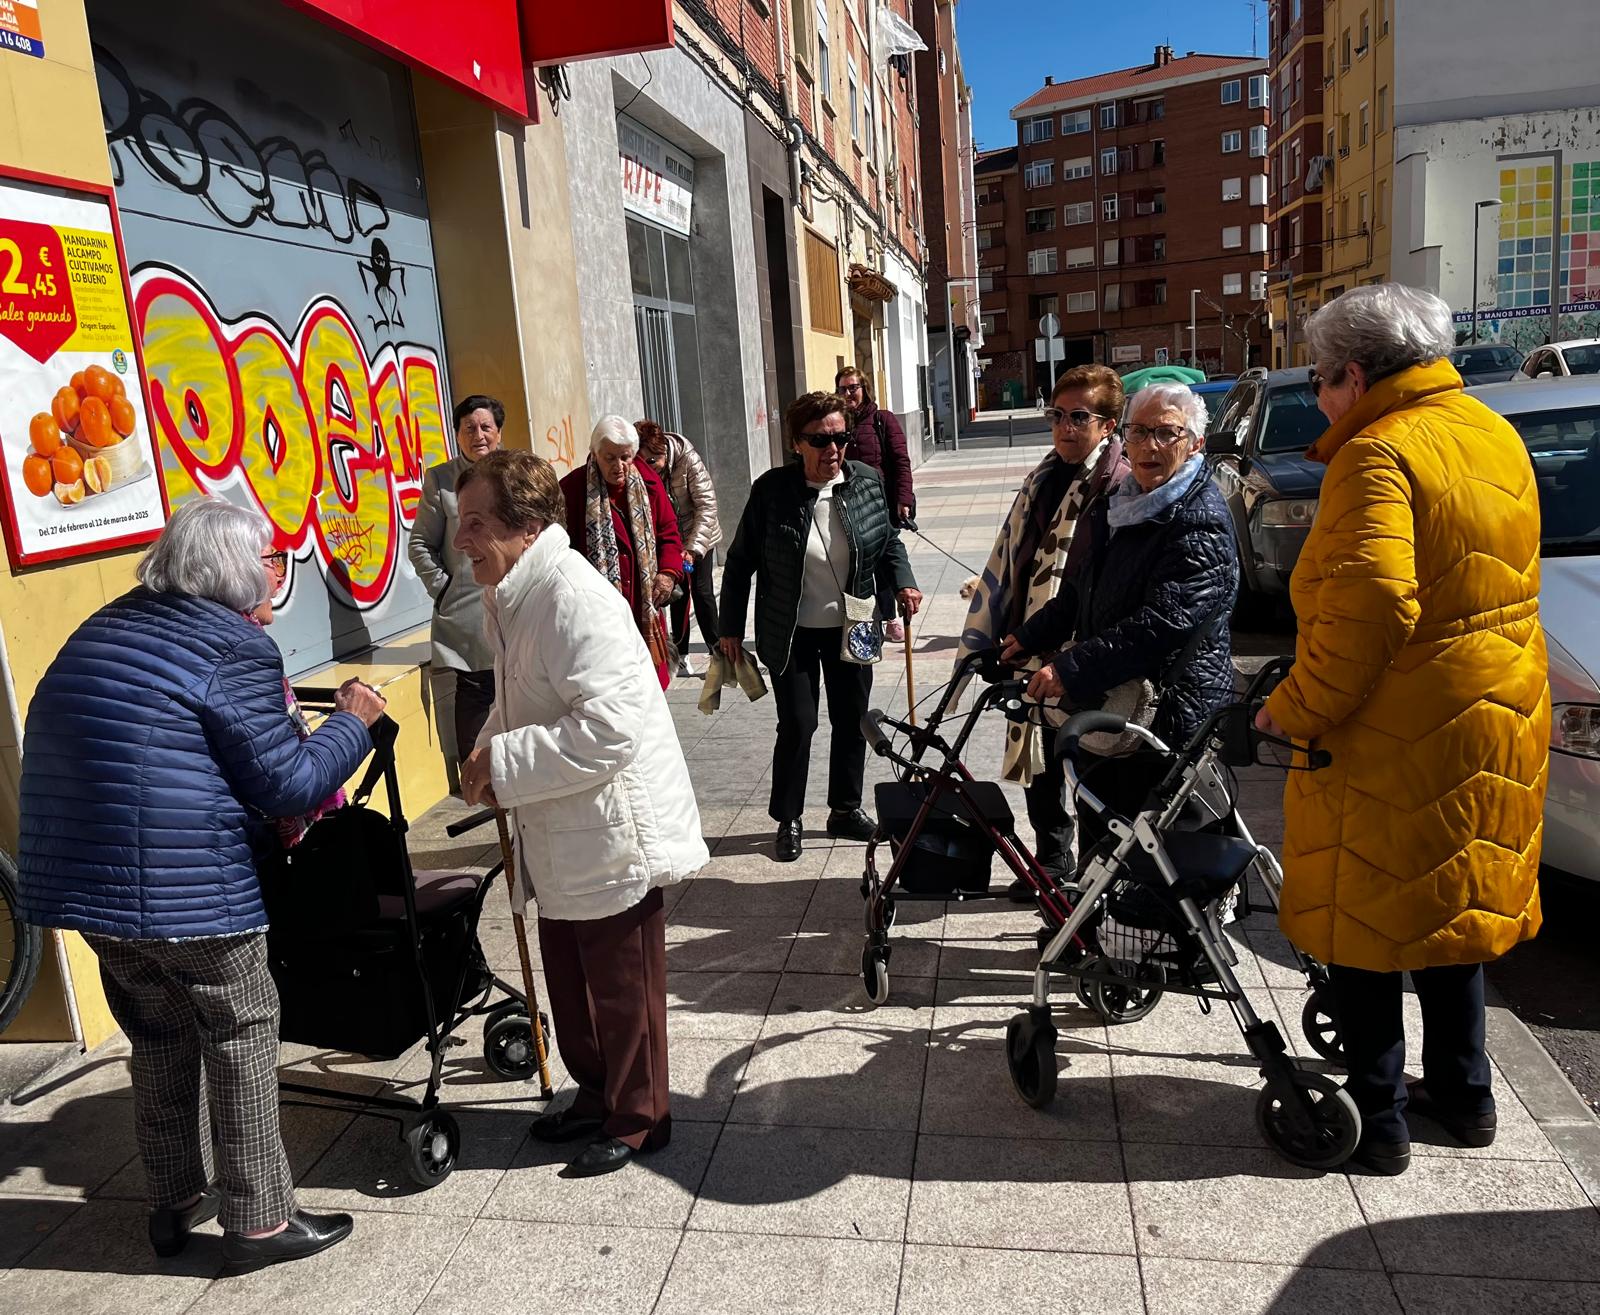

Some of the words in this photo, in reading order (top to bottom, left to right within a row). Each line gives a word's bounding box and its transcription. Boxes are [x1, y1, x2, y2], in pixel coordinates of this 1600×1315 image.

[15, 35, 32, 51] 408
[63, 234, 108, 249] MANDARINA
[67, 247, 102, 260] ALCAMPO
[69, 260, 113, 274] CULTIVAMOS
[71, 272, 81, 283] LO
[82, 273, 107, 285] BUENO
[27, 304, 72, 332] ganando
[1456, 313, 1482, 322] ESTS
[1484, 311, 1513, 319] MANOS
[1515, 309, 1528, 317] NO
[1530, 308, 1547, 316] SON
[39, 528, 50, 537] Del
[50, 526, 58, 535] 27
[59, 524, 67, 533] de
[67, 522, 88, 532] febrero
[89, 519, 95, 528] al
[95, 518, 102, 527] 12
[103, 517, 110, 525] de
[111, 516, 127, 524] marzo
[128, 513, 135, 521] de
[135, 510, 149, 519] 2025
